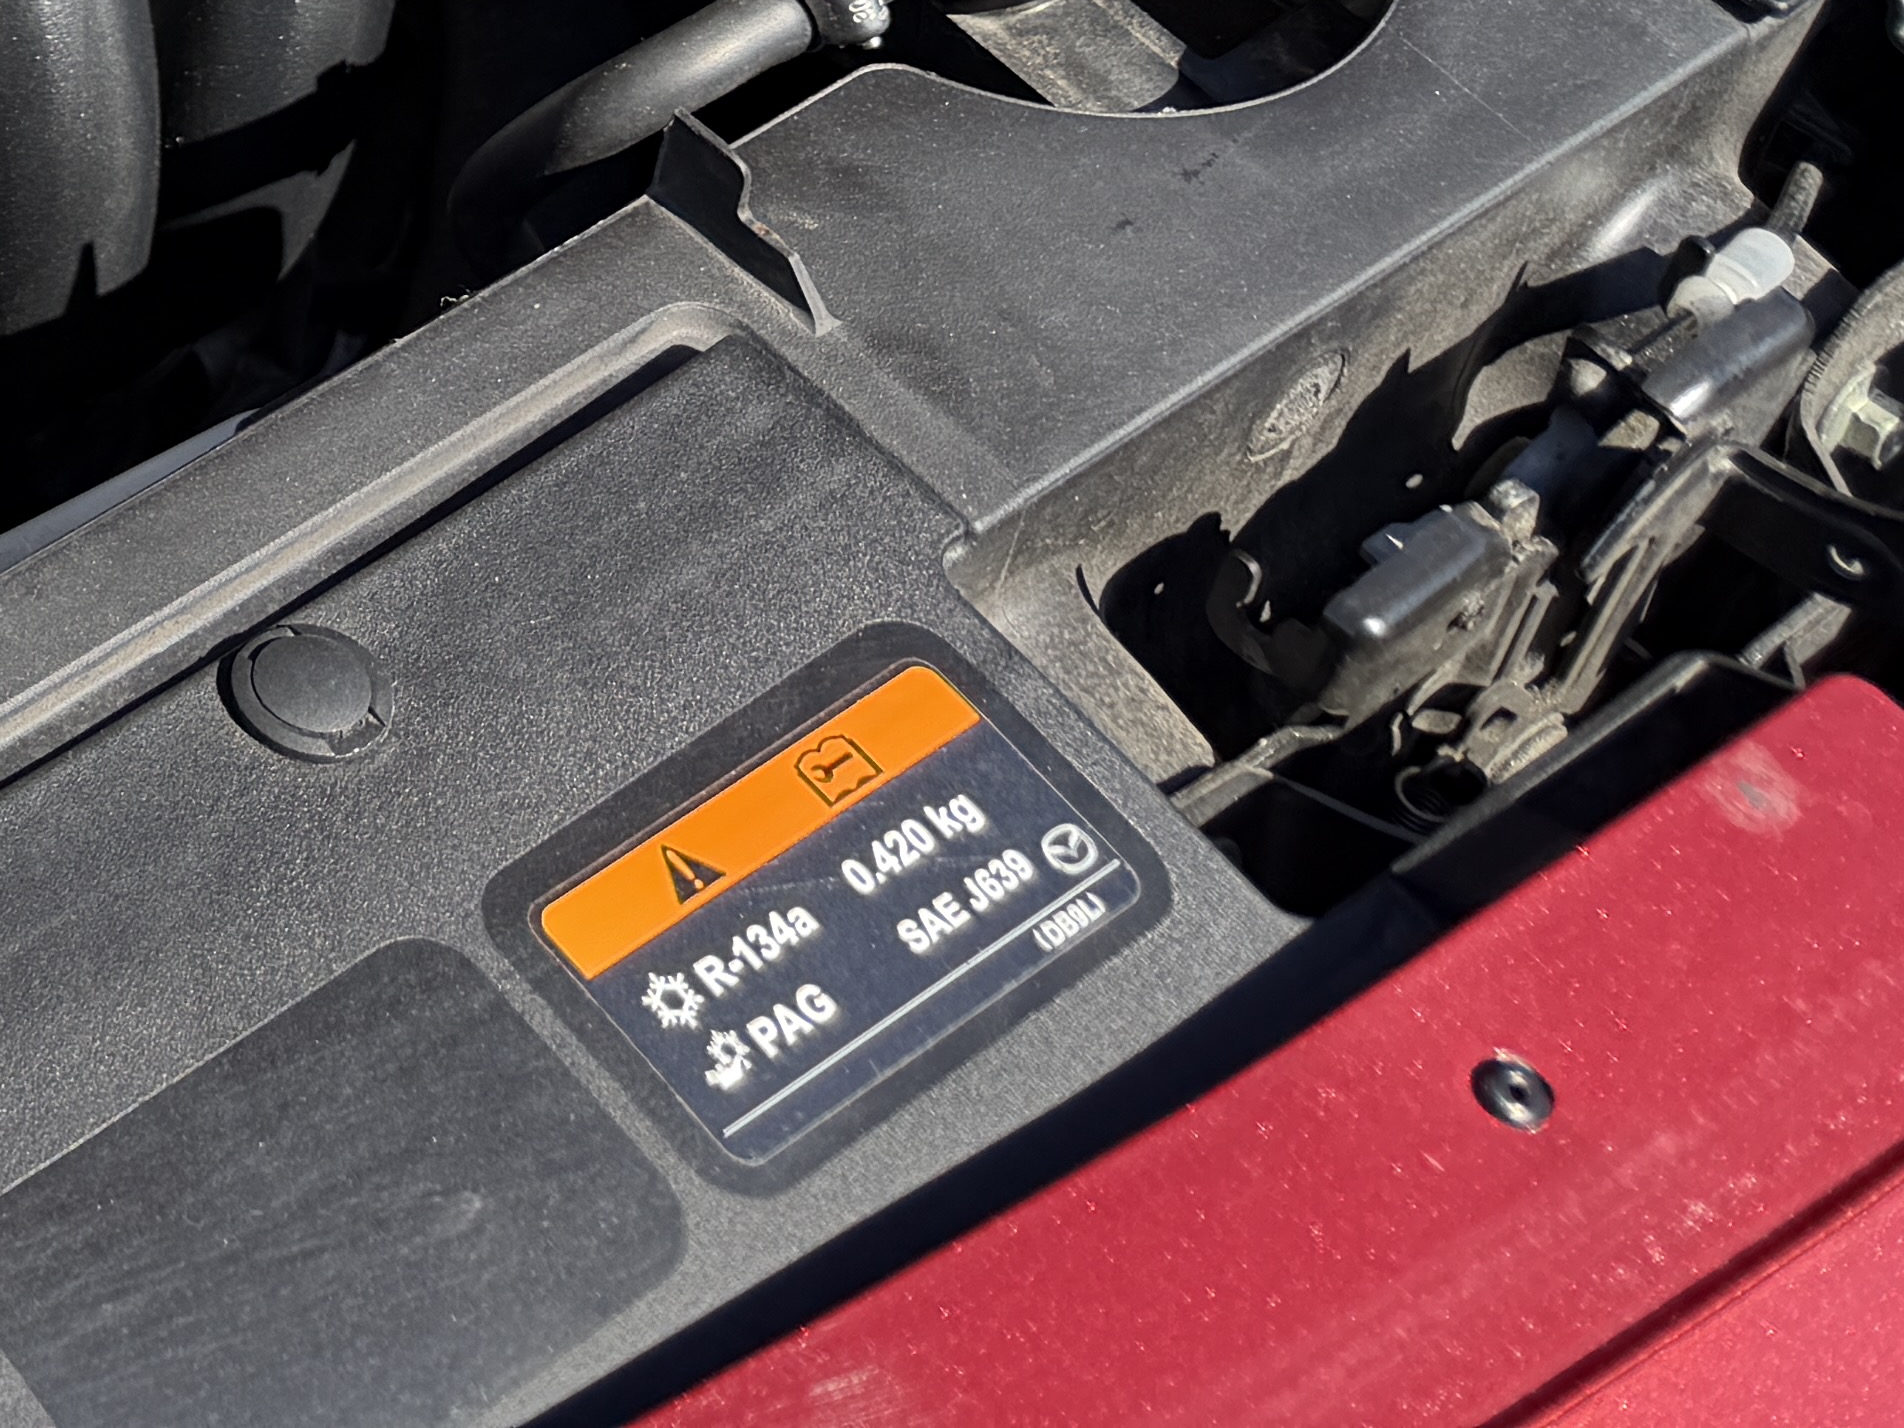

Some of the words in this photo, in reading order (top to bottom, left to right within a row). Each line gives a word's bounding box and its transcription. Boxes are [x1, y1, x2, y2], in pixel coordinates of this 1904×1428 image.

[692, 905, 821, 997] R-134a
[841, 818, 935, 894] 0.420
[922, 793, 986, 839] kg
[745, 983, 838, 1060] PAG
[896, 891, 972, 955] SAE
[964, 848, 1035, 913] J639
